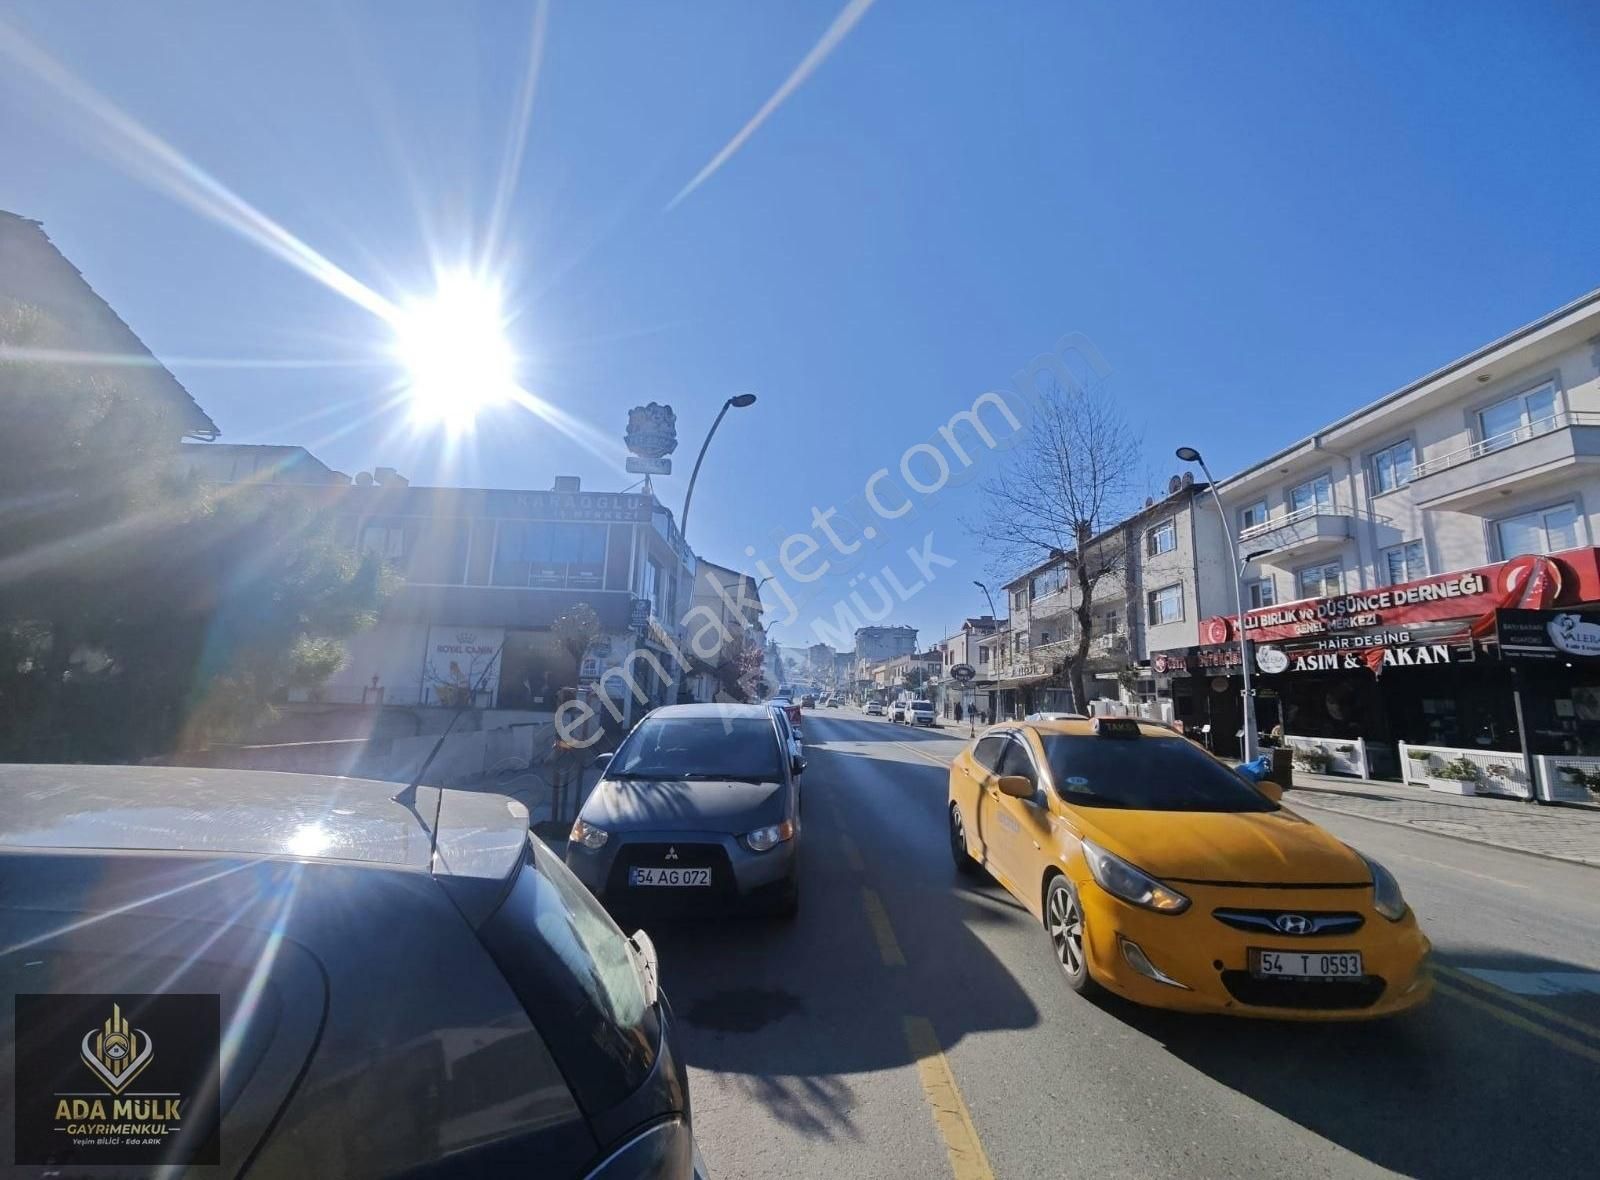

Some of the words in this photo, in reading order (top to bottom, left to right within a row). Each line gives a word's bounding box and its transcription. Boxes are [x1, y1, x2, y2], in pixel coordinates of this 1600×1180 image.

[1317, 592, 1391, 617] DÜŞÜNCE
[1295, 621, 1325, 635] GENEL
[1295, 653, 1339, 671] ASIM
[1343, 652, 1361, 669] &
[1382, 644, 1451, 666] AKAN
[638, 869, 653, 884] 54
[657, 870, 679, 884] AG
[683, 870, 708, 884] 072
[1263, 953, 1283, 972] 54
[1300, 955, 1310, 974] T
[1320, 955, 1359, 975] 0593
